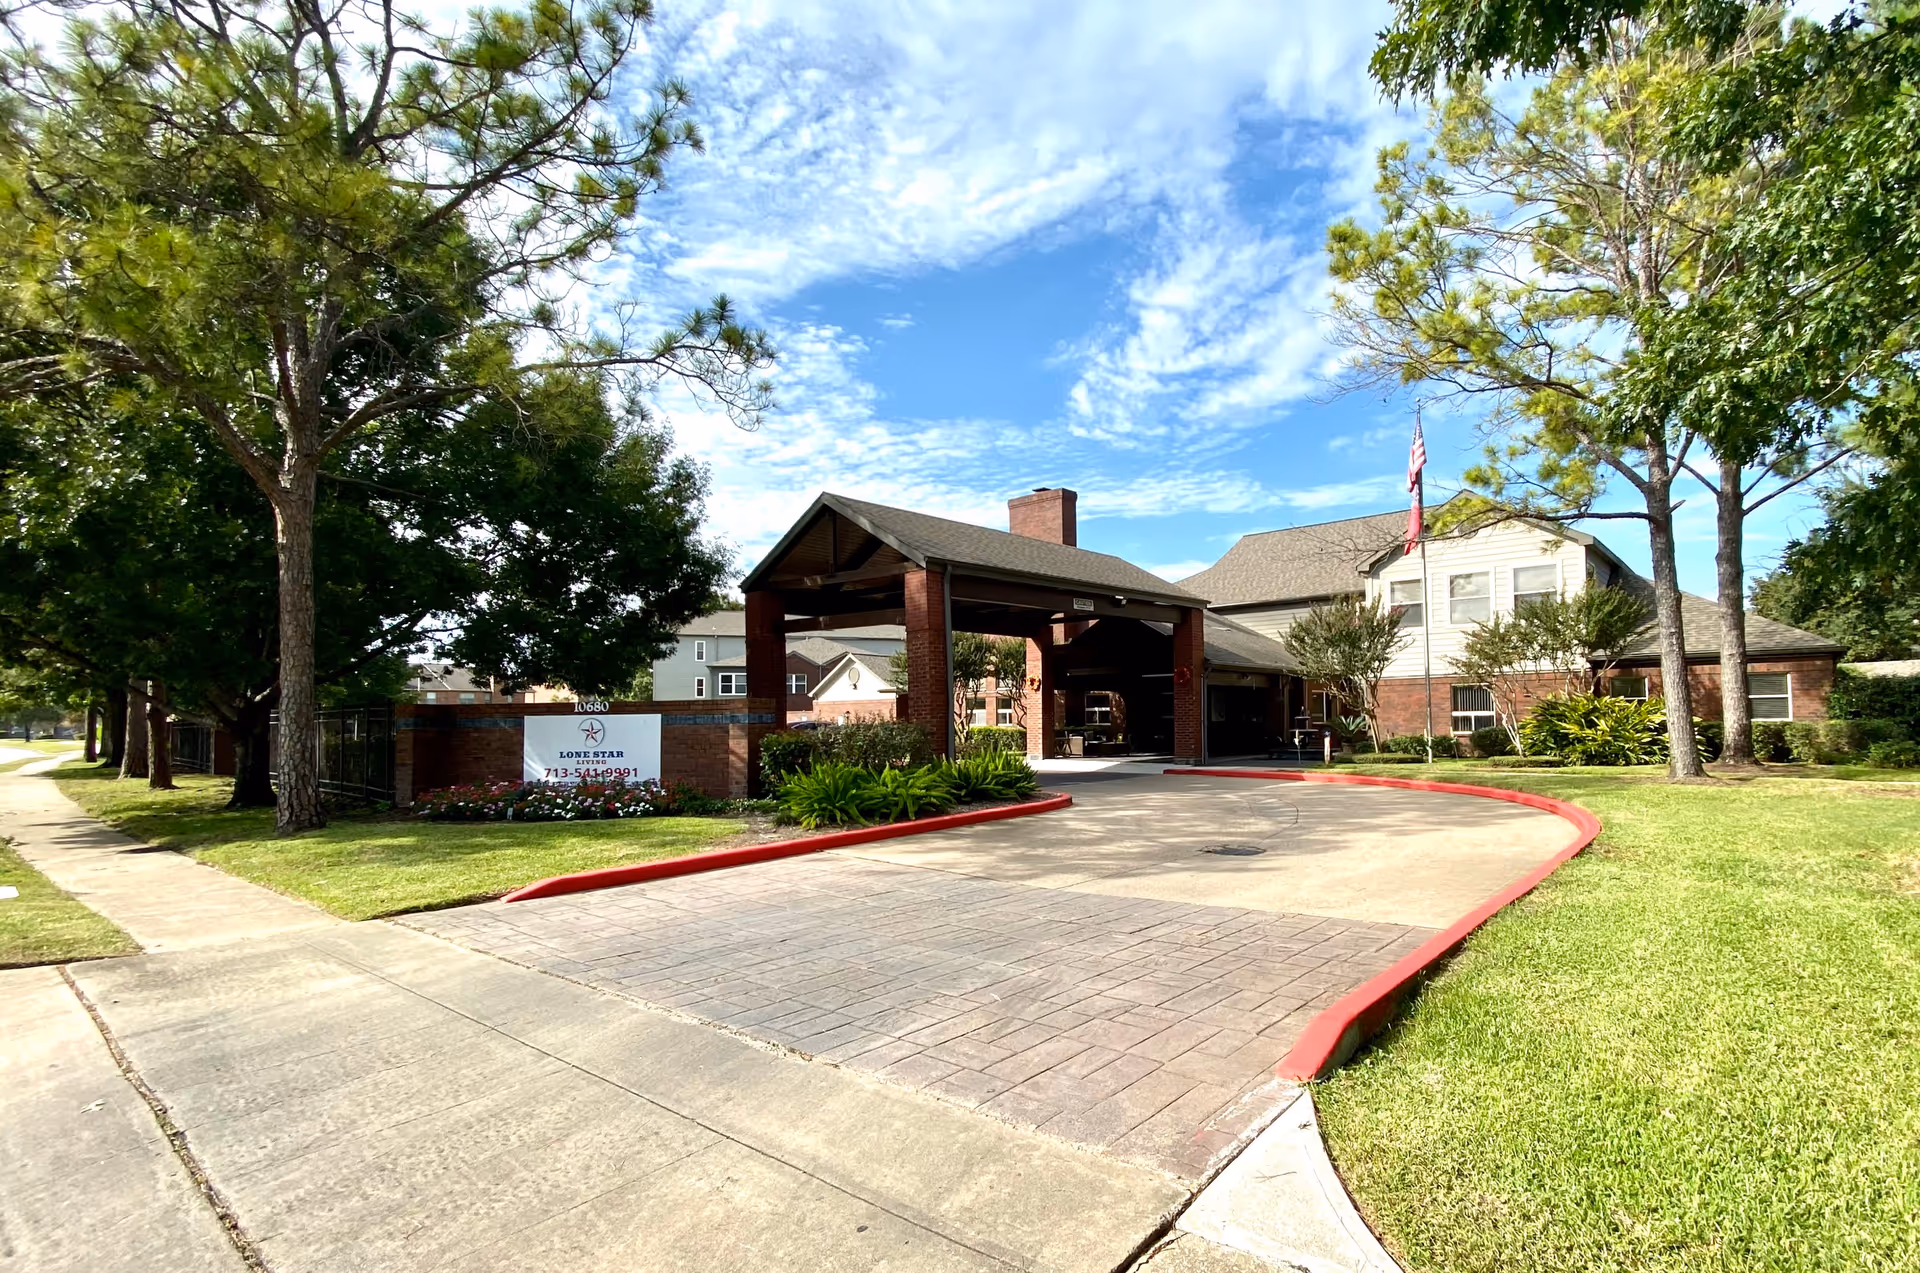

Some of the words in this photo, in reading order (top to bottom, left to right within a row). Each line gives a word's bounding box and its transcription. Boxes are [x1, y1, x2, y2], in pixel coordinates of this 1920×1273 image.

[573, 701, 609, 712] 10680
[559, 751, 591, 759] LONE
[593, 750, 624, 758] STAR
